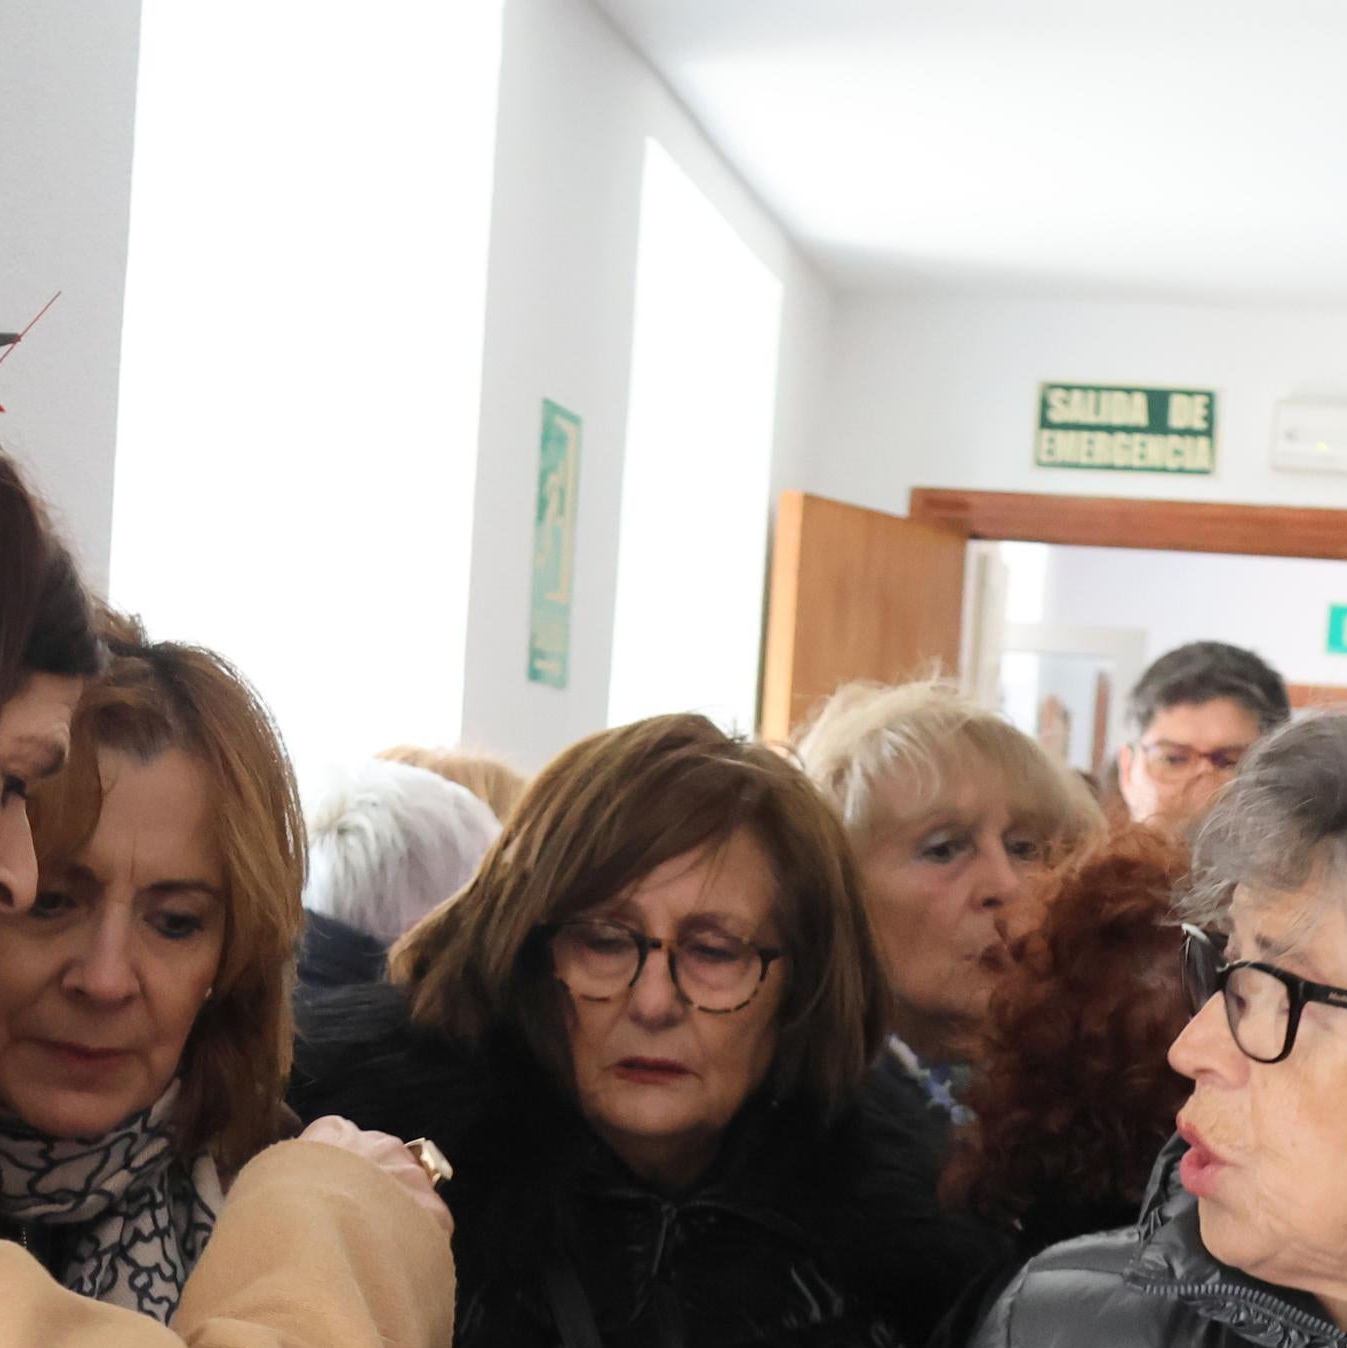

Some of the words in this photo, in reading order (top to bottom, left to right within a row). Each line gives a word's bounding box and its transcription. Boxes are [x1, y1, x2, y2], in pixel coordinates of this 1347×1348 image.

[1046, 387, 1149, 427] SALIDA
[1168, 390, 1209, 431] DE
[1038, 429, 1212, 471] EMERGENCIA
